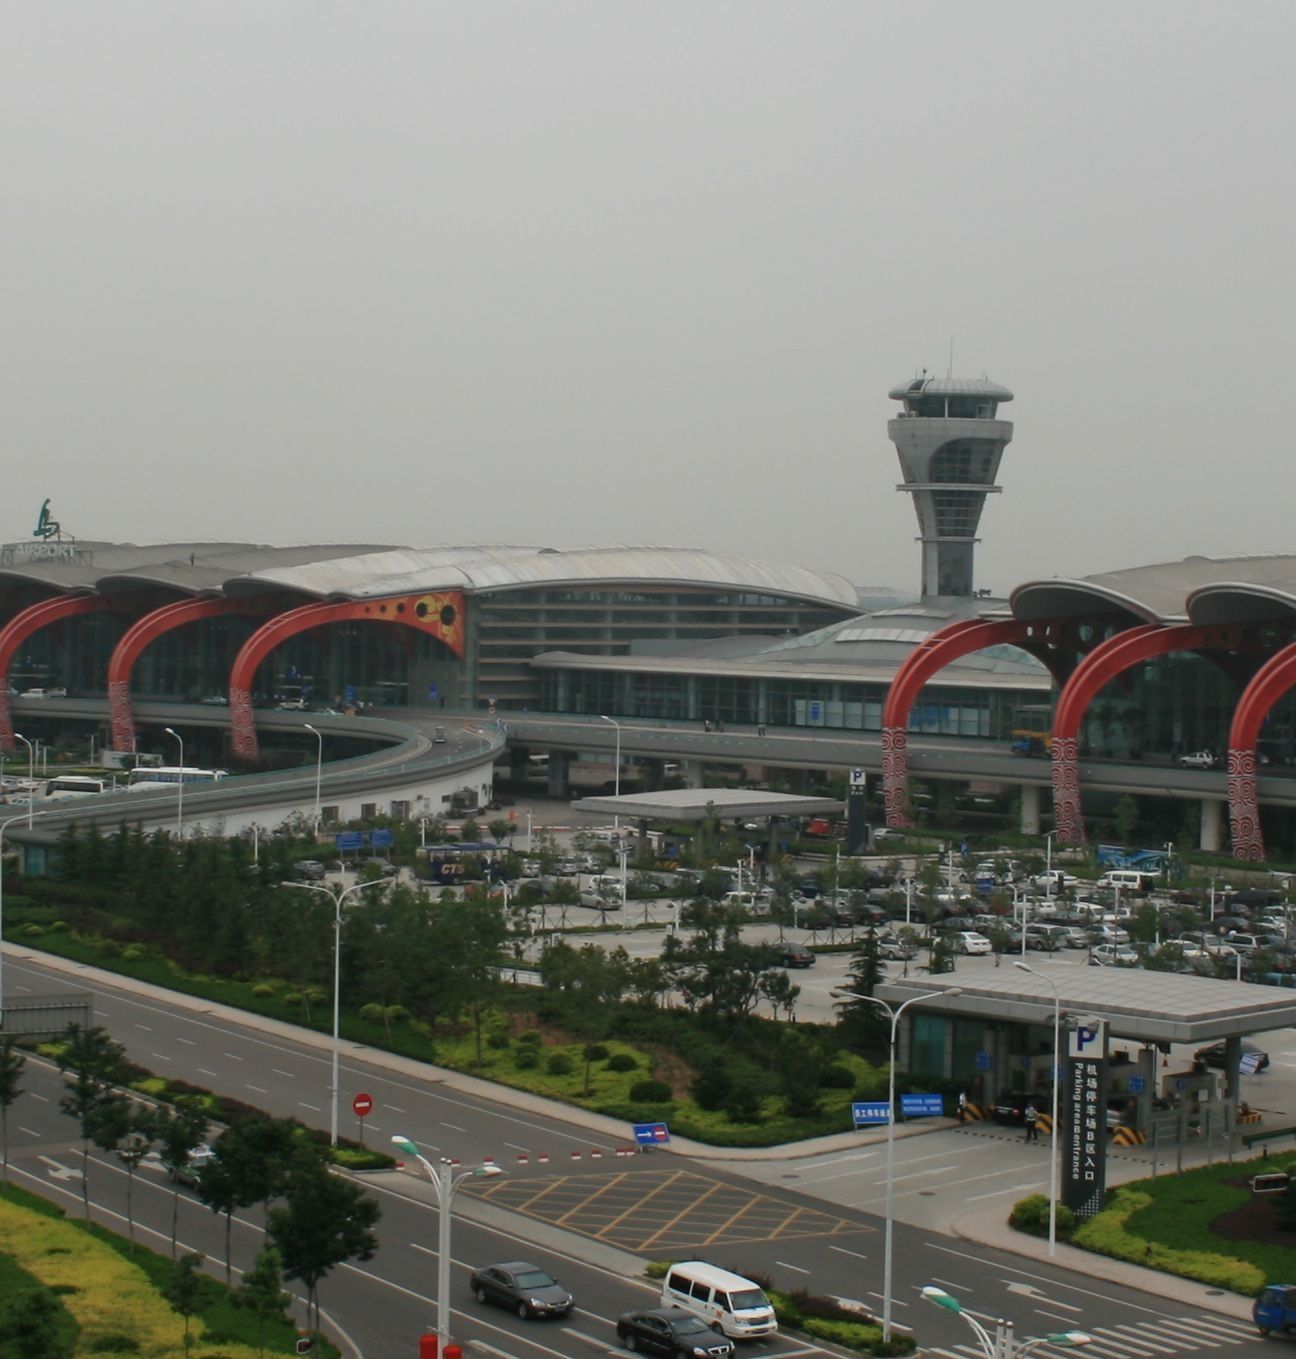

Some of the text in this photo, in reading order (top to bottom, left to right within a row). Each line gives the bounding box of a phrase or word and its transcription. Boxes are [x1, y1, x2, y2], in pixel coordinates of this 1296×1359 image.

[14, 543, 77, 558] AIRPORT
[1077, 1026, 1097, 1052] P
[1072, 1062, 1084, 1101] Parking
